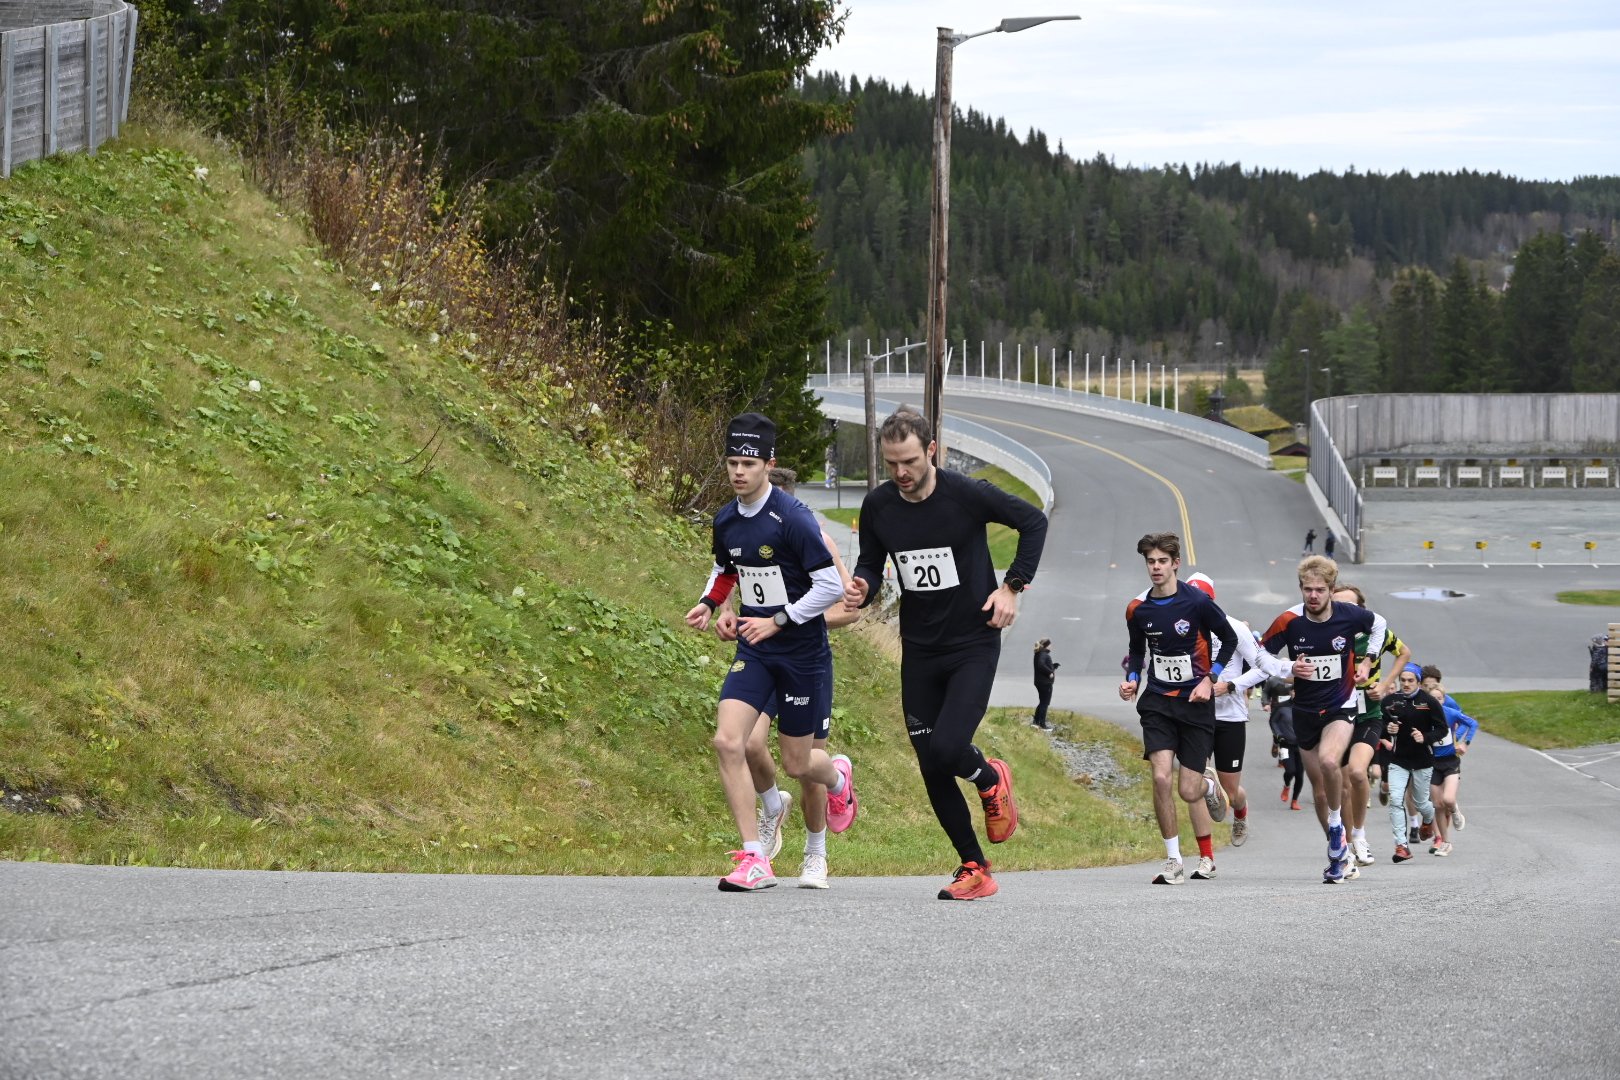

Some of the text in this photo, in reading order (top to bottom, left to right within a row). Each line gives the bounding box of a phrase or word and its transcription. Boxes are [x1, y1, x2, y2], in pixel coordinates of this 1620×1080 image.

[742, 449, 760, 457] NTE
[914, 565, 941, 588] 20
[753, 582, 765, 604] 9
[1165, 667, 1182, 681] 13
[1315, 665, 1331, 680] 12
